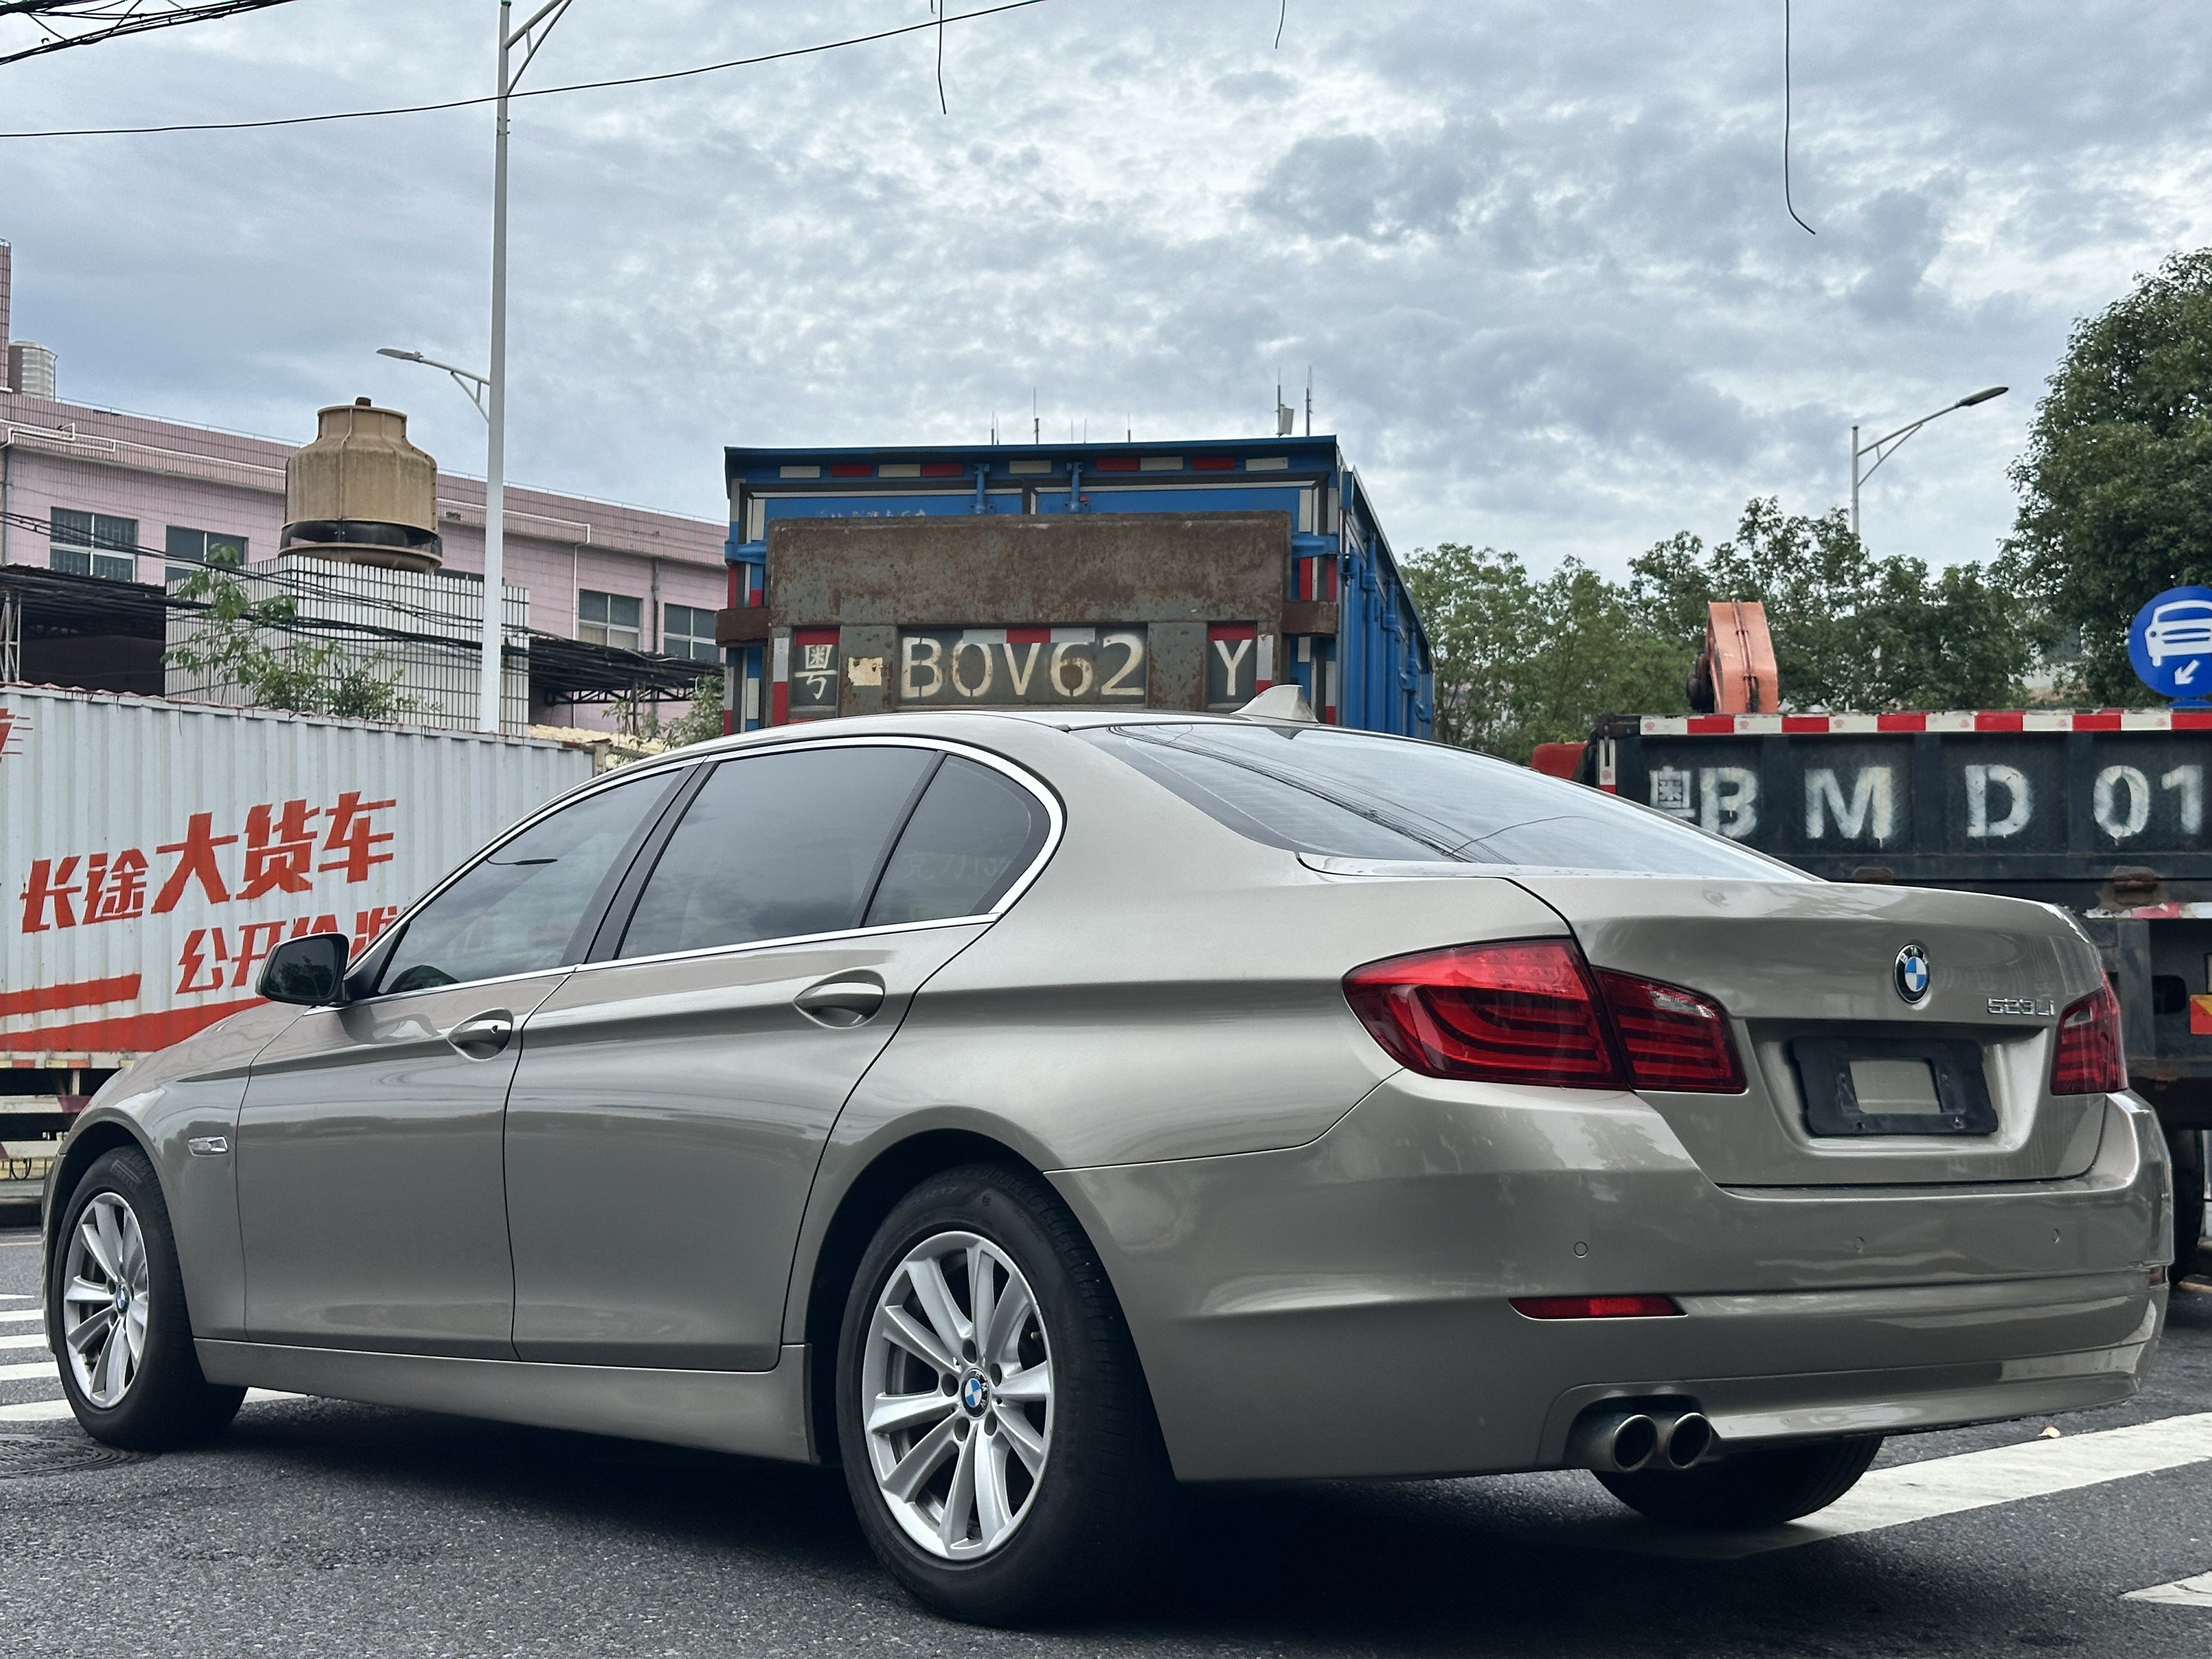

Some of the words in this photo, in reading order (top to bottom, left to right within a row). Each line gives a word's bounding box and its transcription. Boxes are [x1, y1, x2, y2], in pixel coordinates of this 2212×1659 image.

[794, 644, 838, 700] 粤
[1214, 639, 1252, 696] Y
[1804, 766, 1893, 840] M
[1965, 764, 2032, 838] D
[20, 790, 396, 934] 长途大货车
